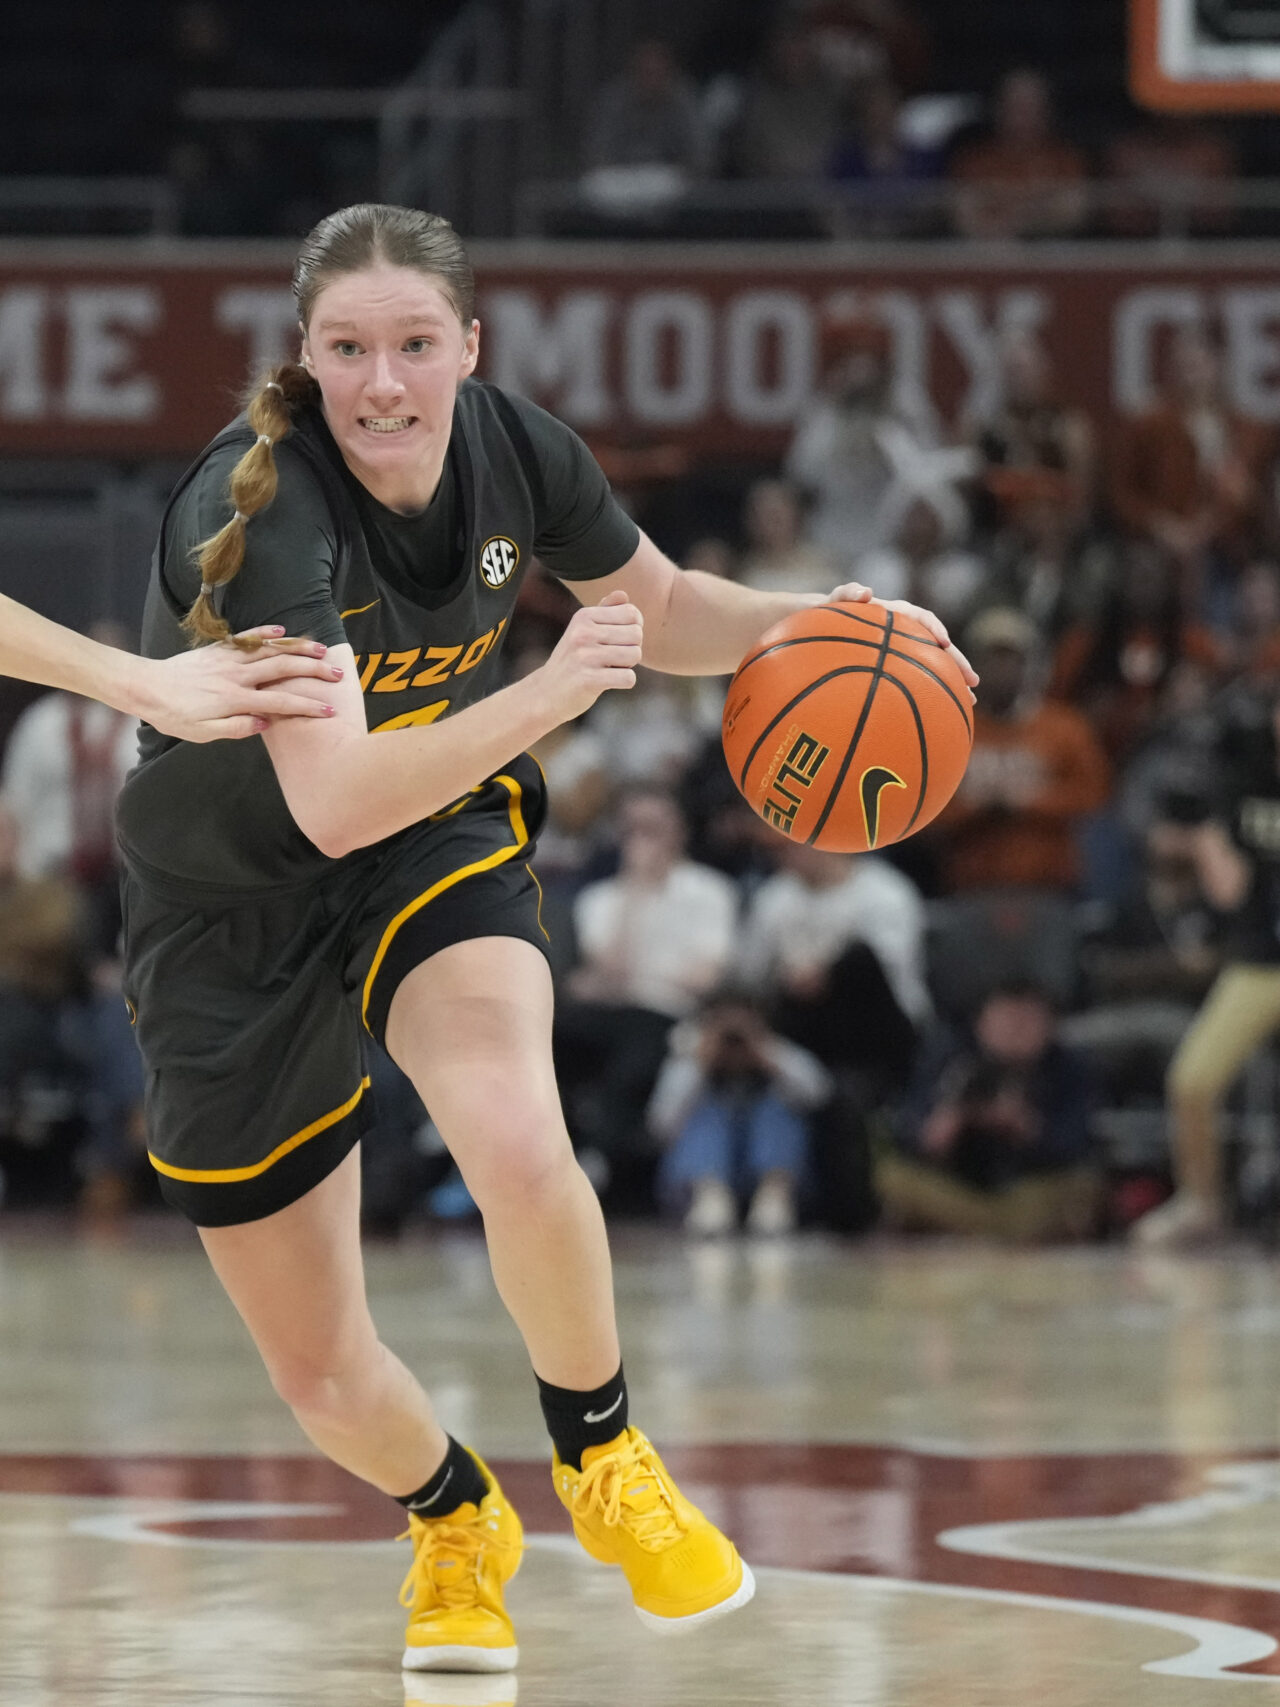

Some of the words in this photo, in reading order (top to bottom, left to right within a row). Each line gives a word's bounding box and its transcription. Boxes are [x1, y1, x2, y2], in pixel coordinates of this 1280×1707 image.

[482, 540, 515, 585] SEC
[354, 617, 507, 693] IZZO
[762, 731, 831, 836] ELITE
